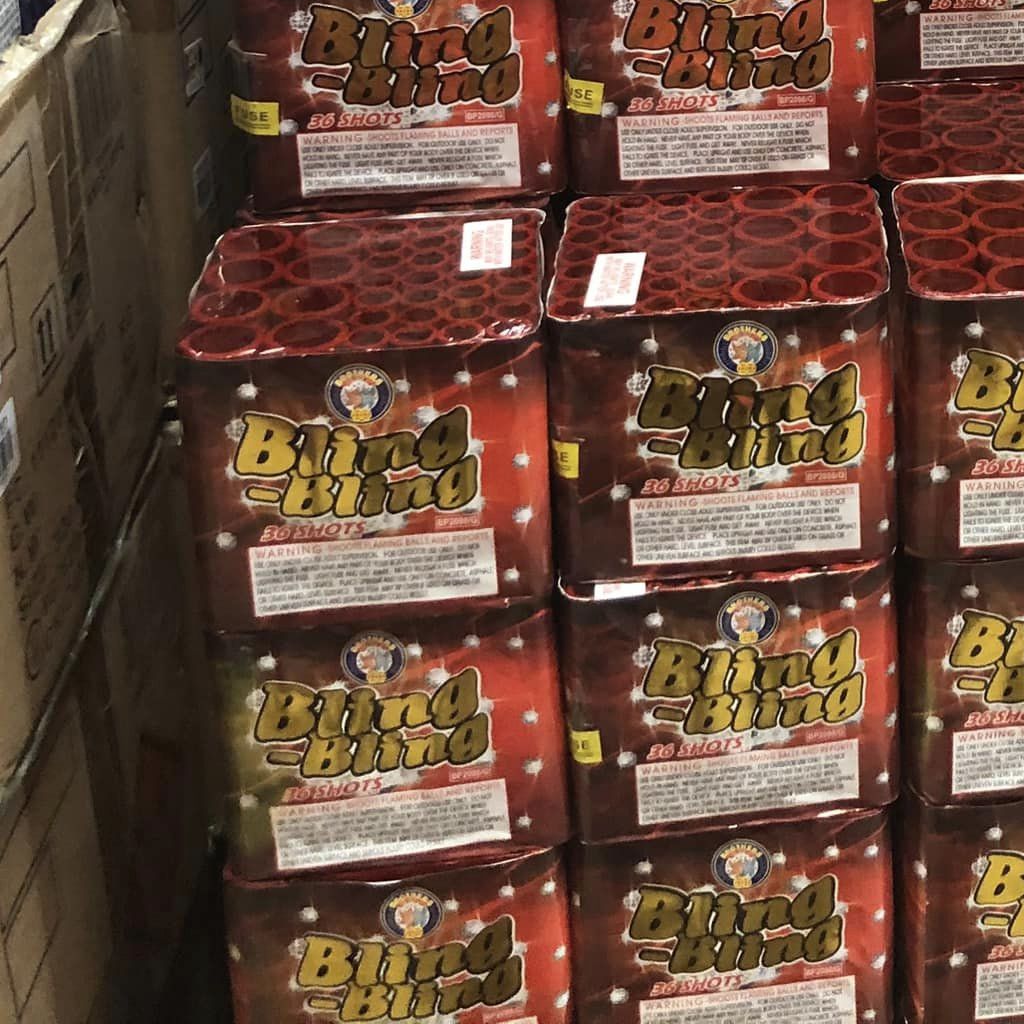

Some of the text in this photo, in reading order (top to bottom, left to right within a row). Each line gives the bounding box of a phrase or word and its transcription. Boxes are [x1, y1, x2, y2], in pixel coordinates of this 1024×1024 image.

[301, 3, 513, 68] Bling
[306, 113, 402, 130] 36 SHOTS
[627, 94, 719, 113] 36 SHOTS
[637, 363, 859, 429] Bling
[233, 404, 472, 478] Bling
[641, 475, 740, 495] 36 SHOTS
[970, 459, 1000, 476] 36
[294, 521, 367, 540] SHOTS
[644, 628, 858, 698] Bling
[254, 666, 480, 744] Bling
[646, 736, 745, 760] 36 SHOTS
[628, 873, 837, 941] Bling
[297, 913, 514, 988] Bling
[679, 975, 743, 995] SHOTS
